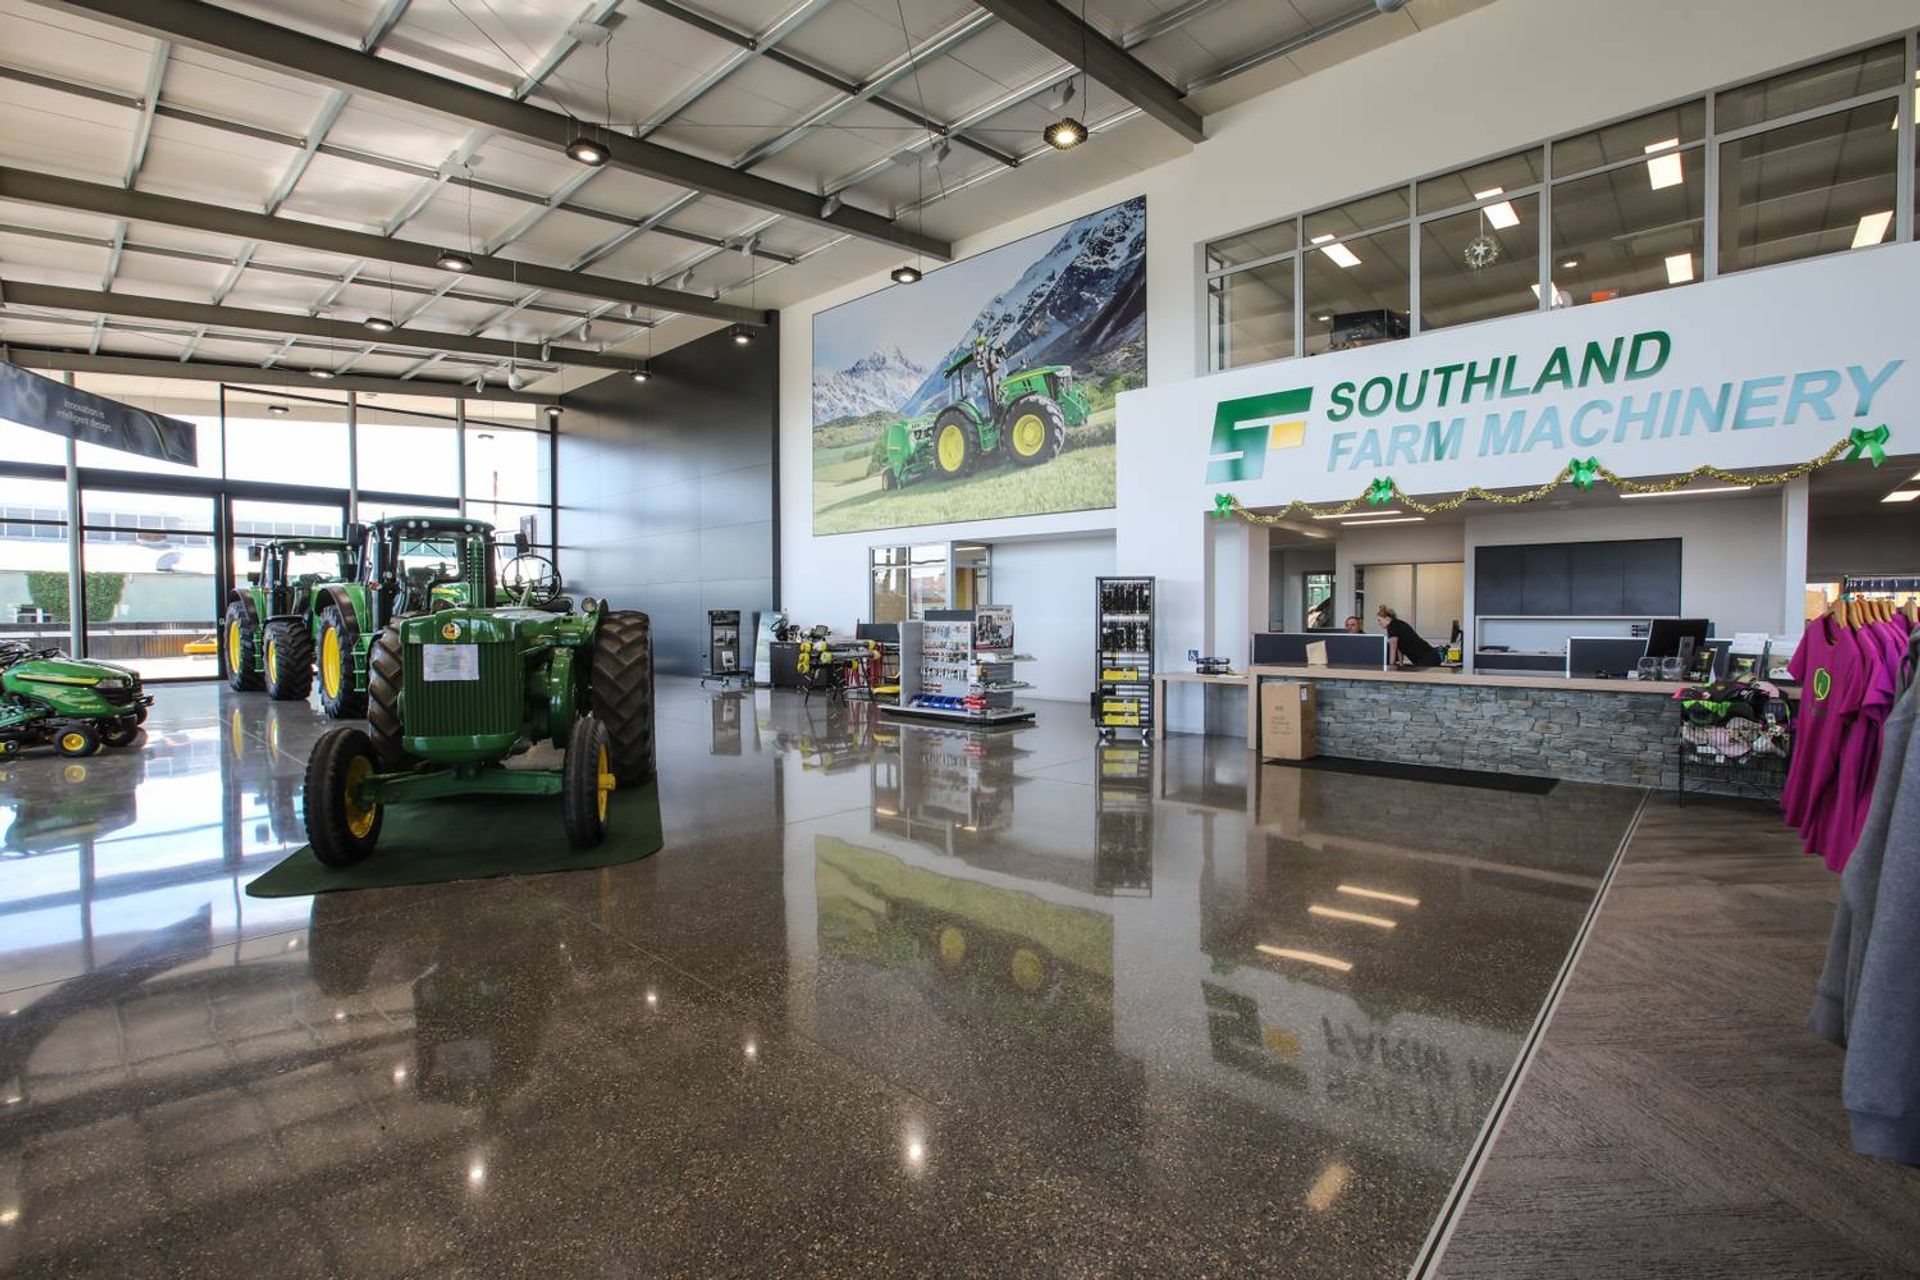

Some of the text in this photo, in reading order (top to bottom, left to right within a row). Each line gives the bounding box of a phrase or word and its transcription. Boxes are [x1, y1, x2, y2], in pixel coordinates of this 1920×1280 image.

[1325, 359, 1905, 473] FARM MACHINERY
[1326, 330, 1672, 423] SOUTHLAND
